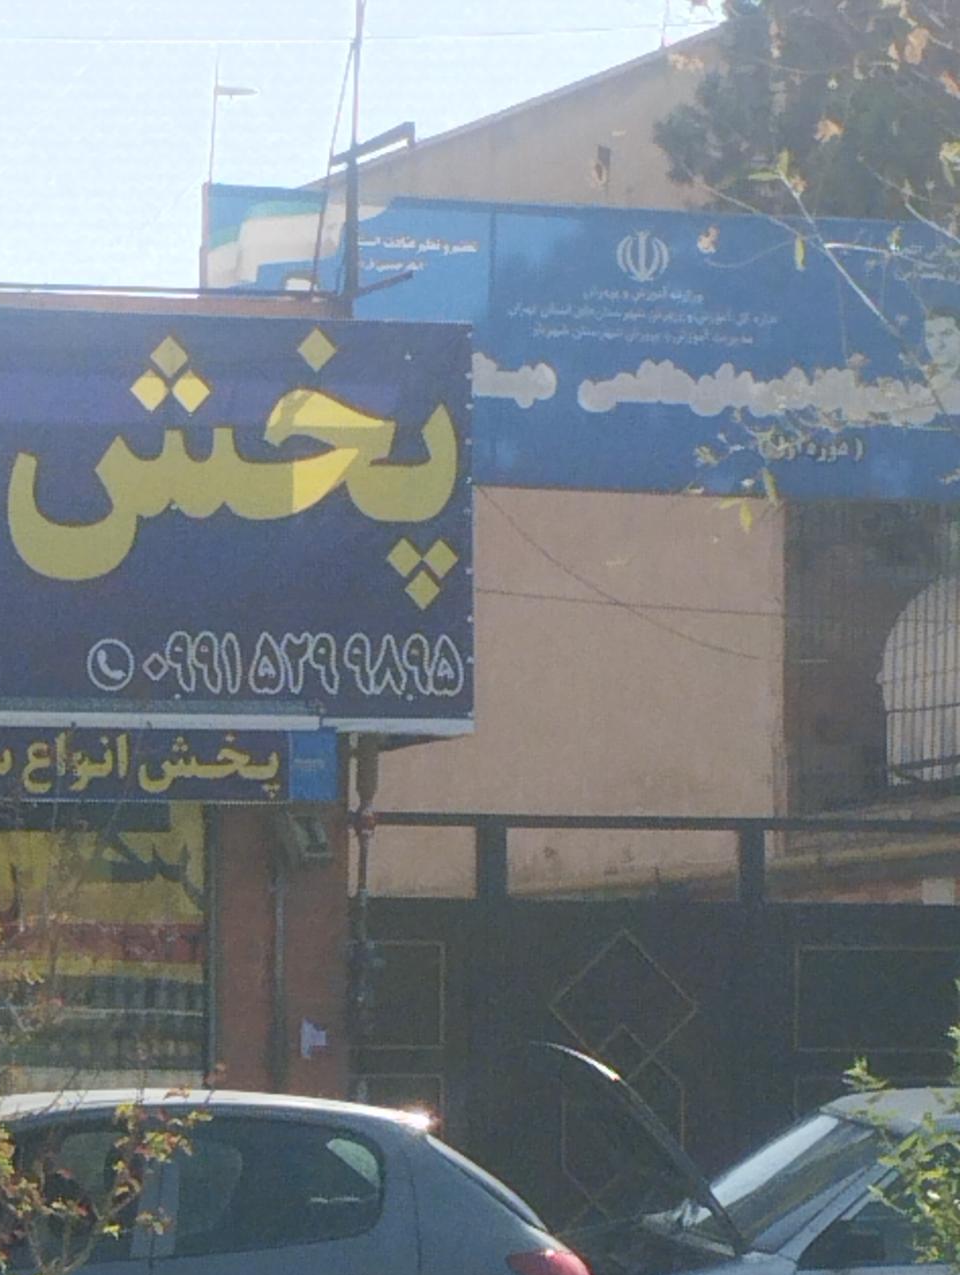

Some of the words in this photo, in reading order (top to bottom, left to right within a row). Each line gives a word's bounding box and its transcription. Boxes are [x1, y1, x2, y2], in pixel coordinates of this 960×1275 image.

[8, 327, 460, 611] پخش
[22, 731, 130, 793] انواع
[138, 734, 281, 799] پخش
